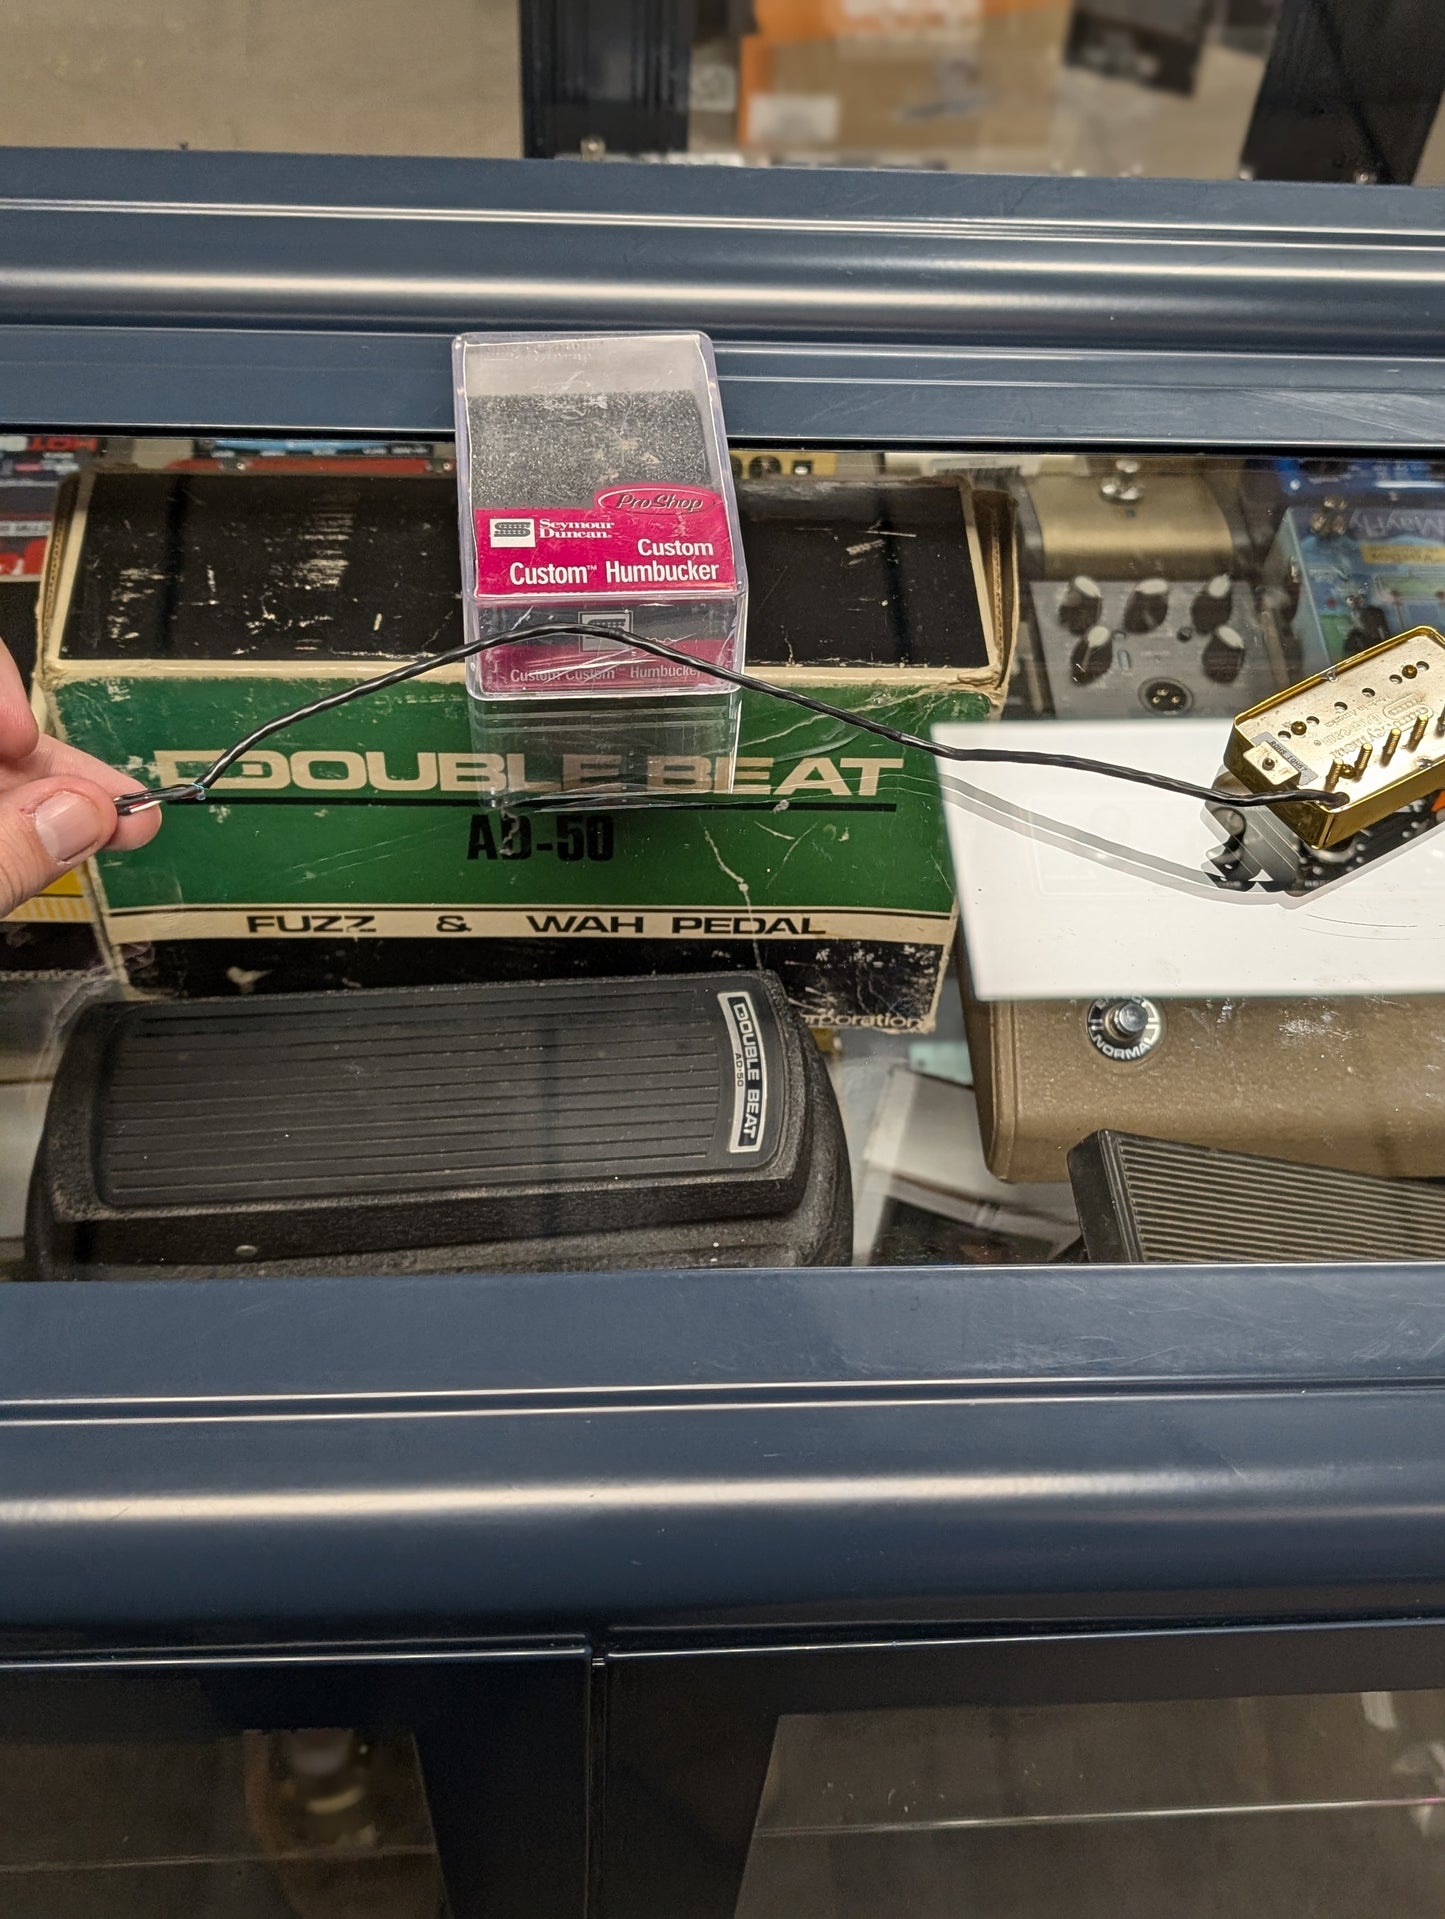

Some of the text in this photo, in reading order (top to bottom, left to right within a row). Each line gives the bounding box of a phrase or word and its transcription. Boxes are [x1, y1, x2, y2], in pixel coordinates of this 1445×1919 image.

[539, 518, 615, 531] Seymour
[637, 538, 713, 556] Custom
[605, 560, 719, 583] Humbucker
[510, 667, 560, 683] Custom
[153, 749, 904, 797] DOUBLE BEAT
[467, 813, 614, 862] AD-50
[246, 914, 827, 936] FUZZ & WAH PEDAL
[804, 1012, 922, 1030] rporation
[1091, 1034, 1154, 1060] NORMAL
[733, 1002, 761, 1139] DOUBLE BEAT
